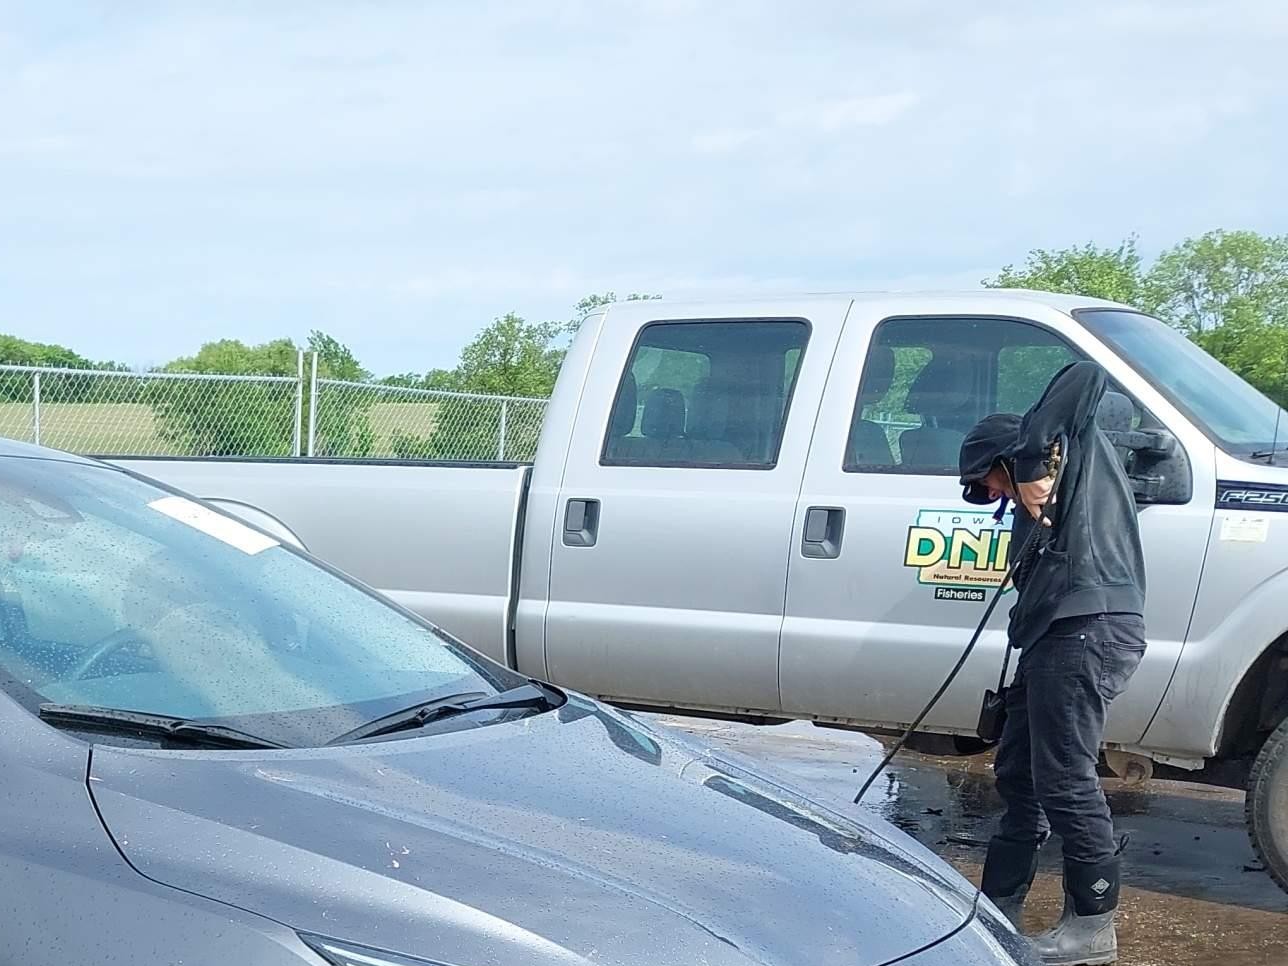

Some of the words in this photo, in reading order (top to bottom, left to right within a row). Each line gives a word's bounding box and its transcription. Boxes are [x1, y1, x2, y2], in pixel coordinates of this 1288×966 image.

[933, 573, 962, 581] Natural
[964, 575, 1002, 583] Resources
[936, 588, 984, 600] Fisheries
